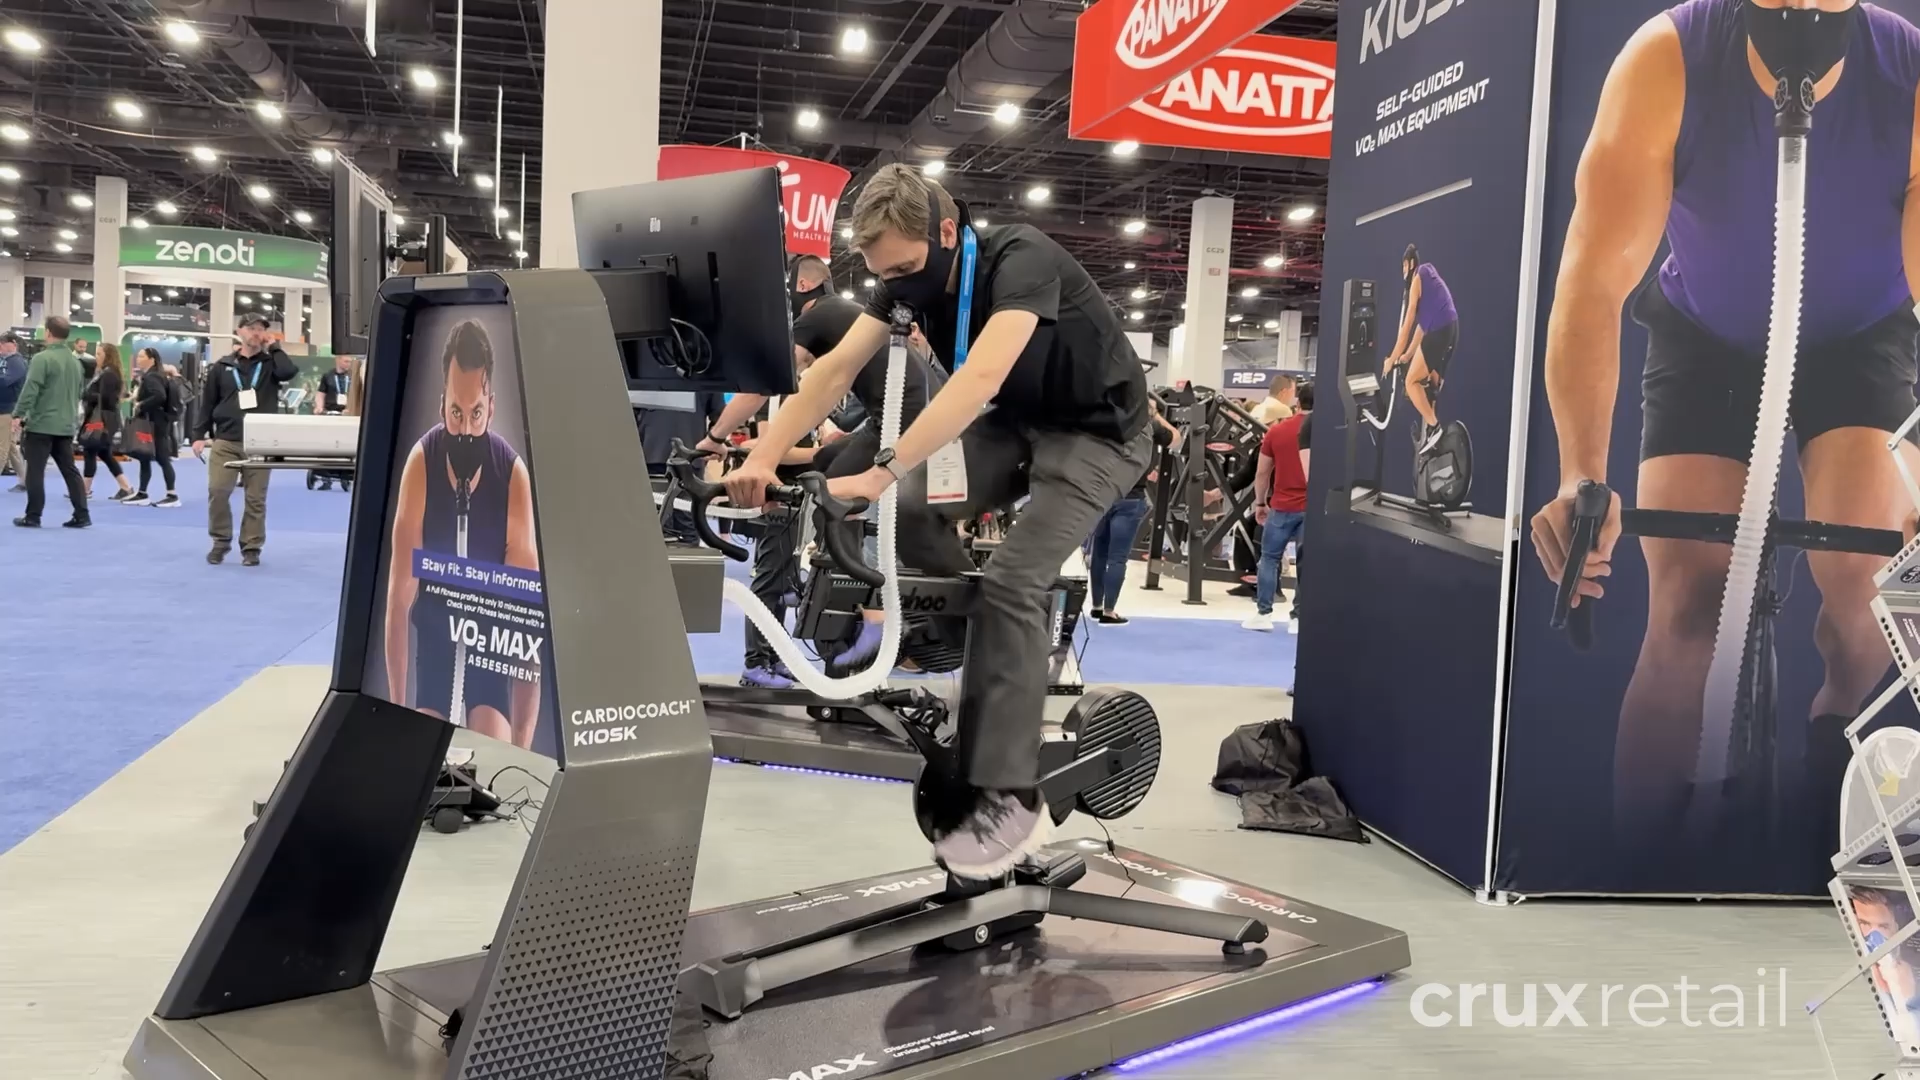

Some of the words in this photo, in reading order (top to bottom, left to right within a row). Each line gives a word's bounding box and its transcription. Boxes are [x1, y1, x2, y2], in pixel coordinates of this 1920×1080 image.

[1129, 0, 1217, 56] PANA
[1360, 0, 1465, 64] KIO
[1150, 68, 1334, 121] ANATT
[1376, 61, 1464, 121] SELF-GUIDED
[1355, 135, 1376, 157] VO2
[1377, 117, 1406, 147] MAX
[1406, 78, 1490, 131] EQUIPMENT
[155, 237, 255, 267] zenoti
[1232, 372, 1267, 384] REP
[422, 558, 445, 576] Stay
[448, 562, 463, 577] fit.
[465, 566, 490, 585] Stay
[440, 588, 460, 599] fitness
[460, 593, 479, 604] profile
[485, 599, 497, 609] only
[504, 603, 527, 614] minutes
[446, 599, 463, 610] Check
[464, 603, 477, 612] your
[477, 606, 497, 618] fitness
[497, 611, 511, 621] level
[511, 615, 525, 624] now
[525, 617, 539, 628] with
[449, 615, 487, 653] VO2
[490, 626, 543, 664] MAX
[468, 654, 540, 683] ASSESSMENT
[573, 725, 638, 747] KIOSK
[854, 876, 932, 897] MAX
[883, 1037, 931, 1053] Discover
[933, 1029, 959, 1040] your
[893, 1044, 930, 1058] unique
[930, 1033, 970, 1047] fitness
[969, 1025, 995, 1036] level
